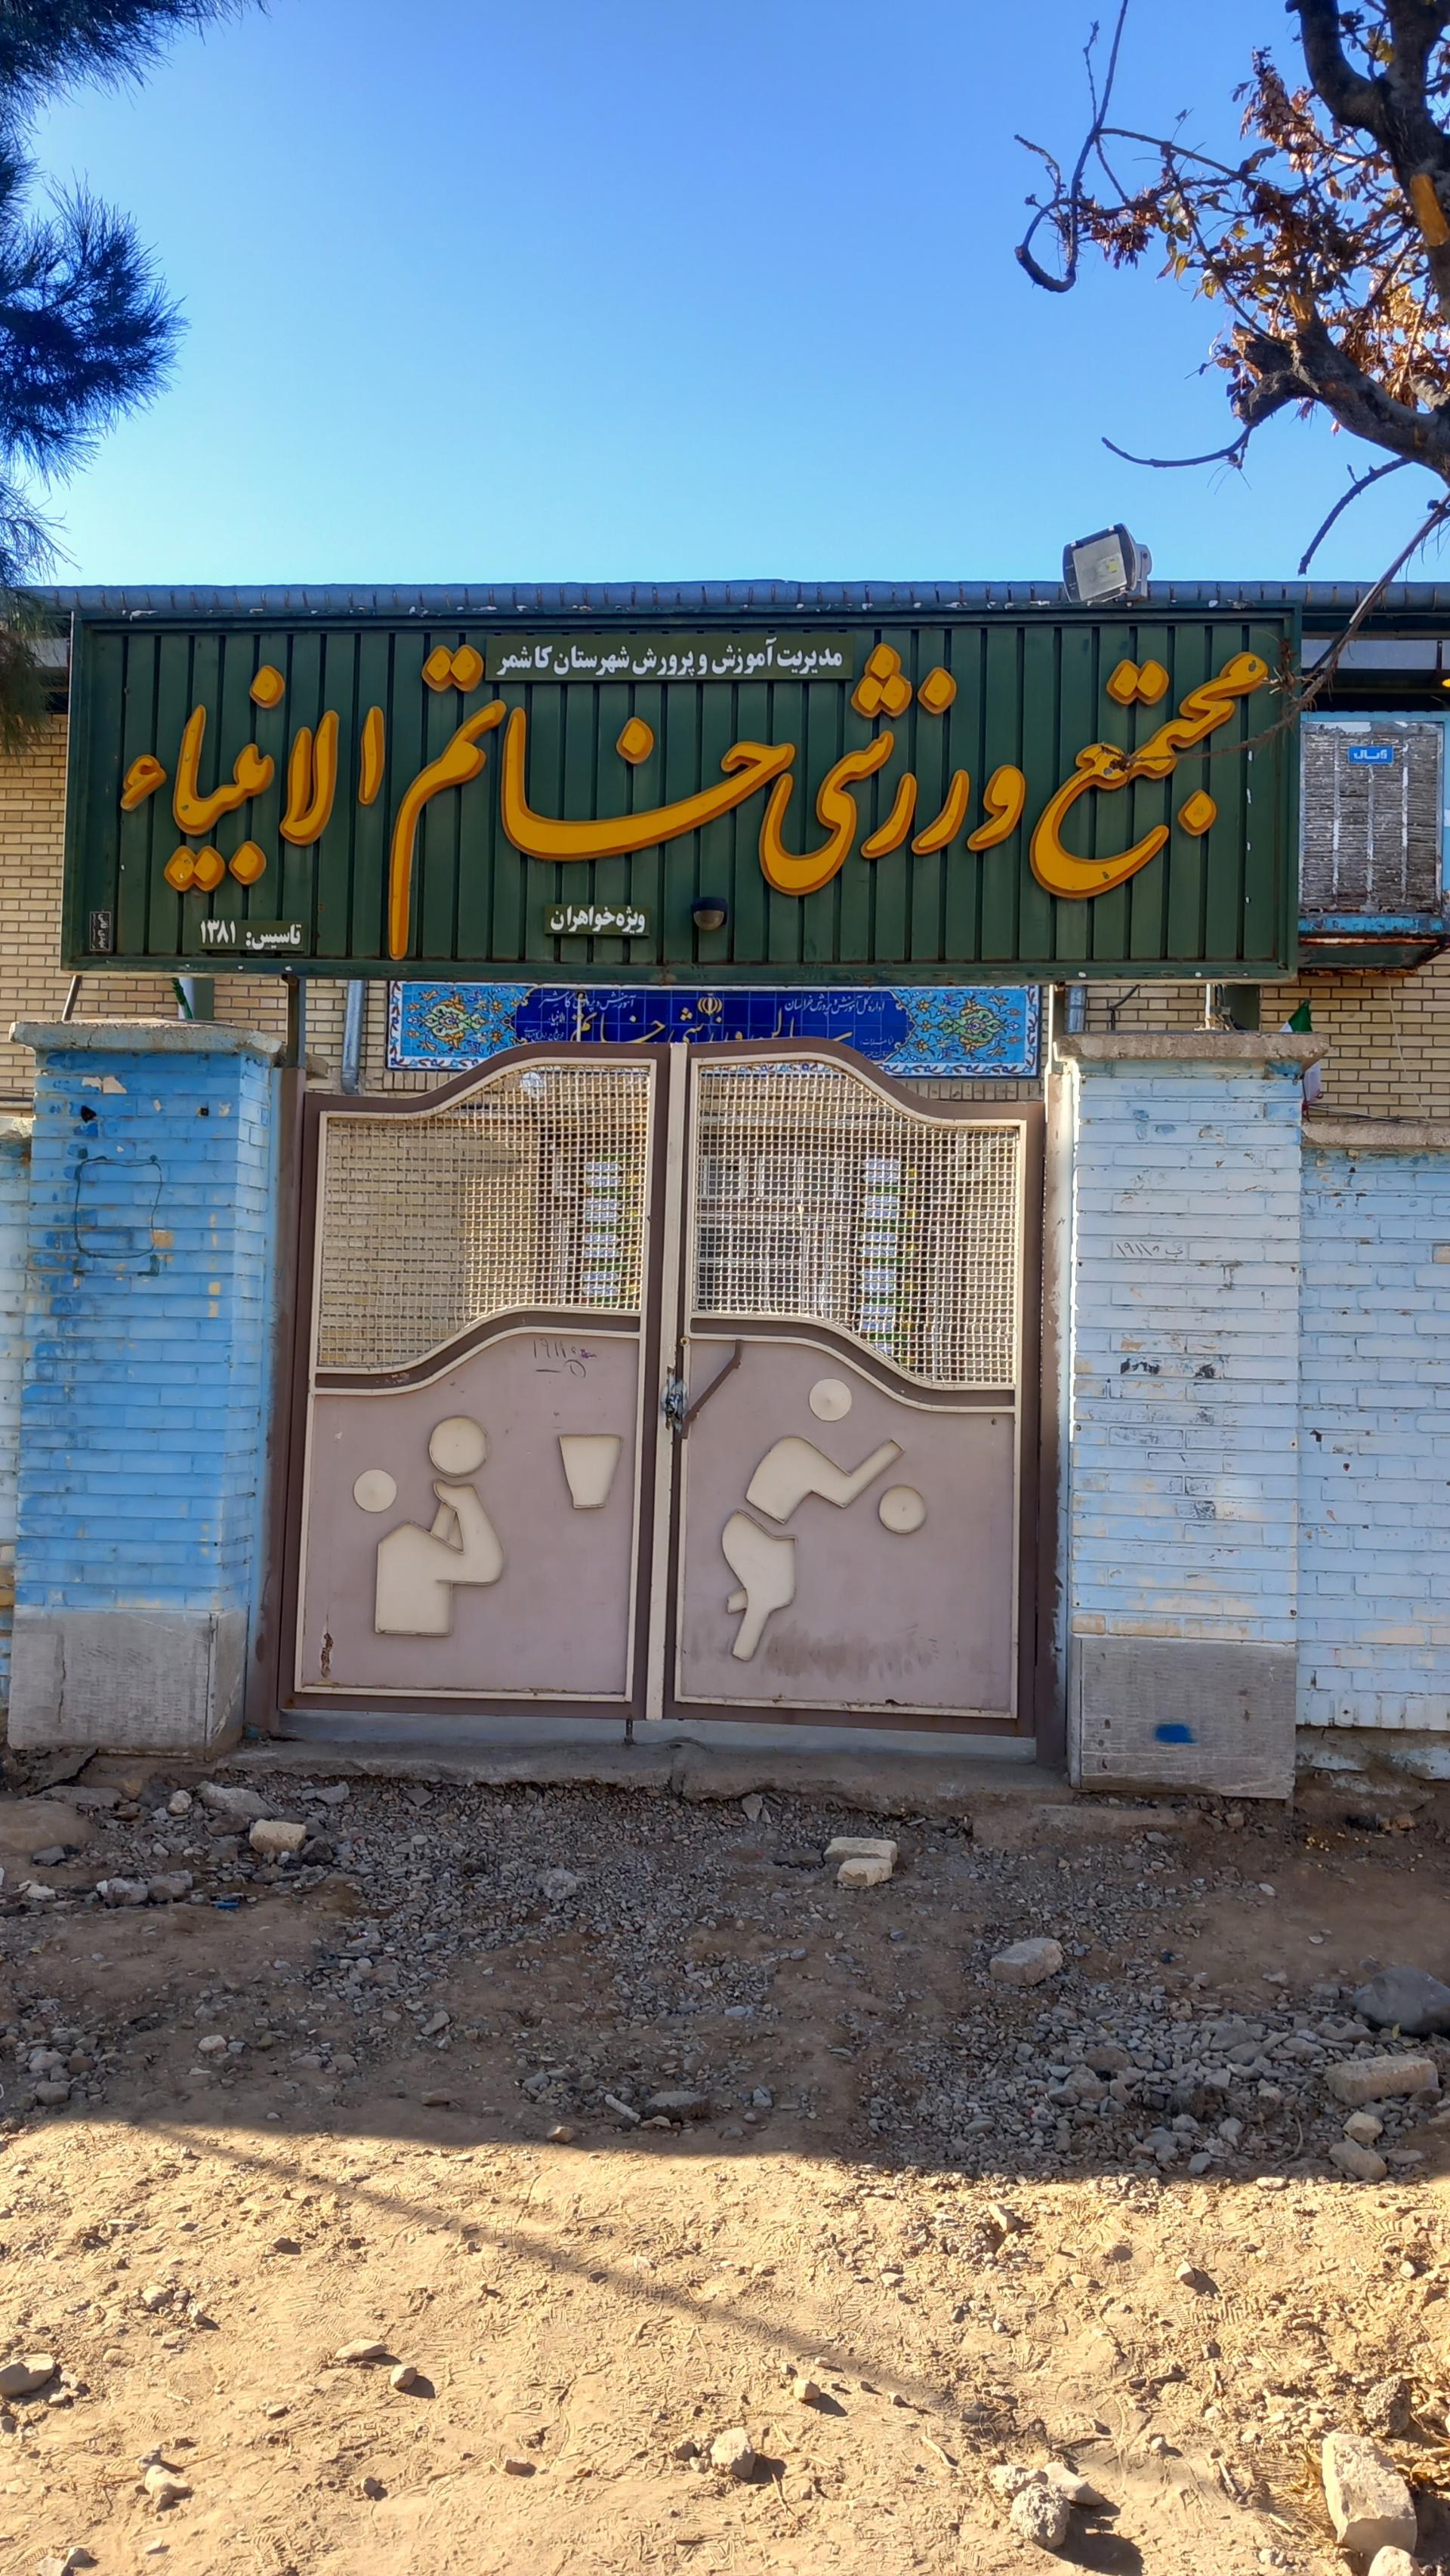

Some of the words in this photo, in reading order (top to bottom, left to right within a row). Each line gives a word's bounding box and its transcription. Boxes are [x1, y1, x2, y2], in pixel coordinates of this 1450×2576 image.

[495, 645, 553, 676] کاشمر
[554, 645, 630, 675] شهرستان
[632, 647, 696, 677] پرورش
[696, 653, 708, 675] و
[712, 637, 777, 674] آموزش
[776, 647, 843, 674] مدیریت
[758, 642, 1026, 897] ورزشی
[1029, 652, 1270, 899] مجتمع
[388, 643, 796, 961] خاتم
[200, 920, 236, 944] ۱۳۸۱
[550, 905, 616, 933] خواهران
[616, 905, 646, 934] ویژه
